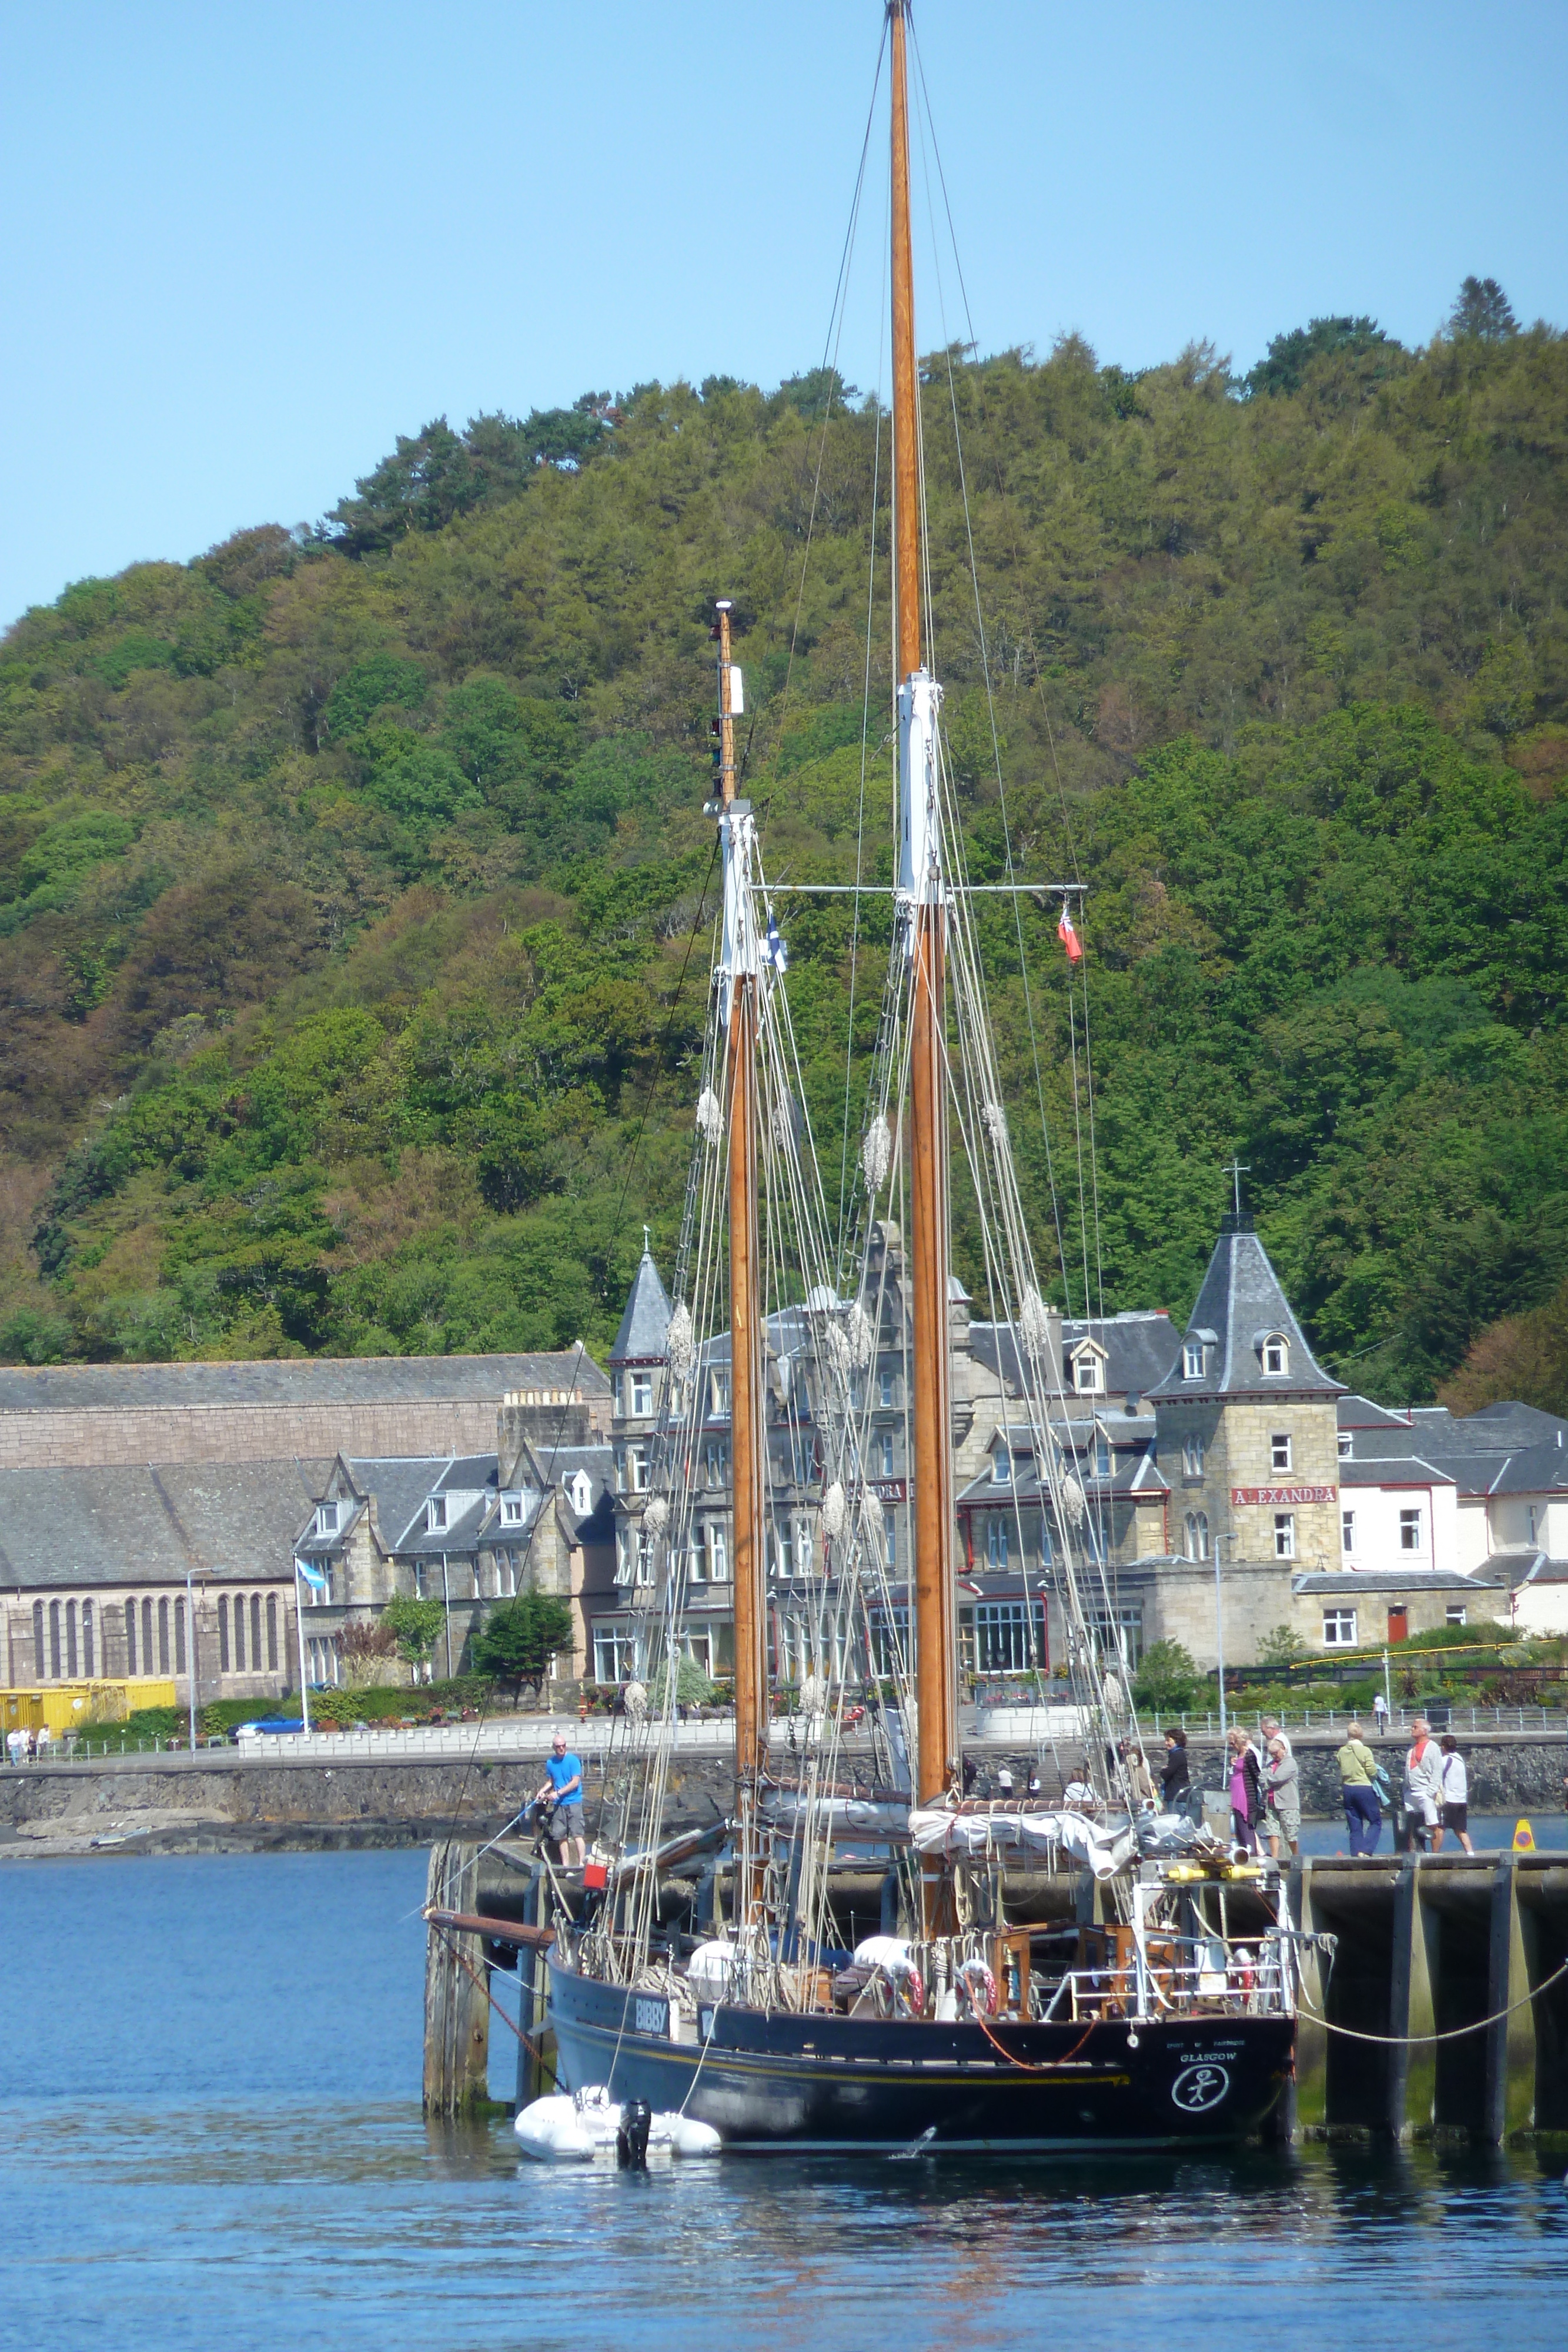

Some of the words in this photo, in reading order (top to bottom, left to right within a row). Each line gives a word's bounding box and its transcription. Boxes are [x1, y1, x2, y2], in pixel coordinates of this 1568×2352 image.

[1235, 1488, 1335, 1504] ALEXANDRA
[636, 1999, 667, 2033] BIBBY
[1180, 2052, 1237, 2062] GLASGOW
